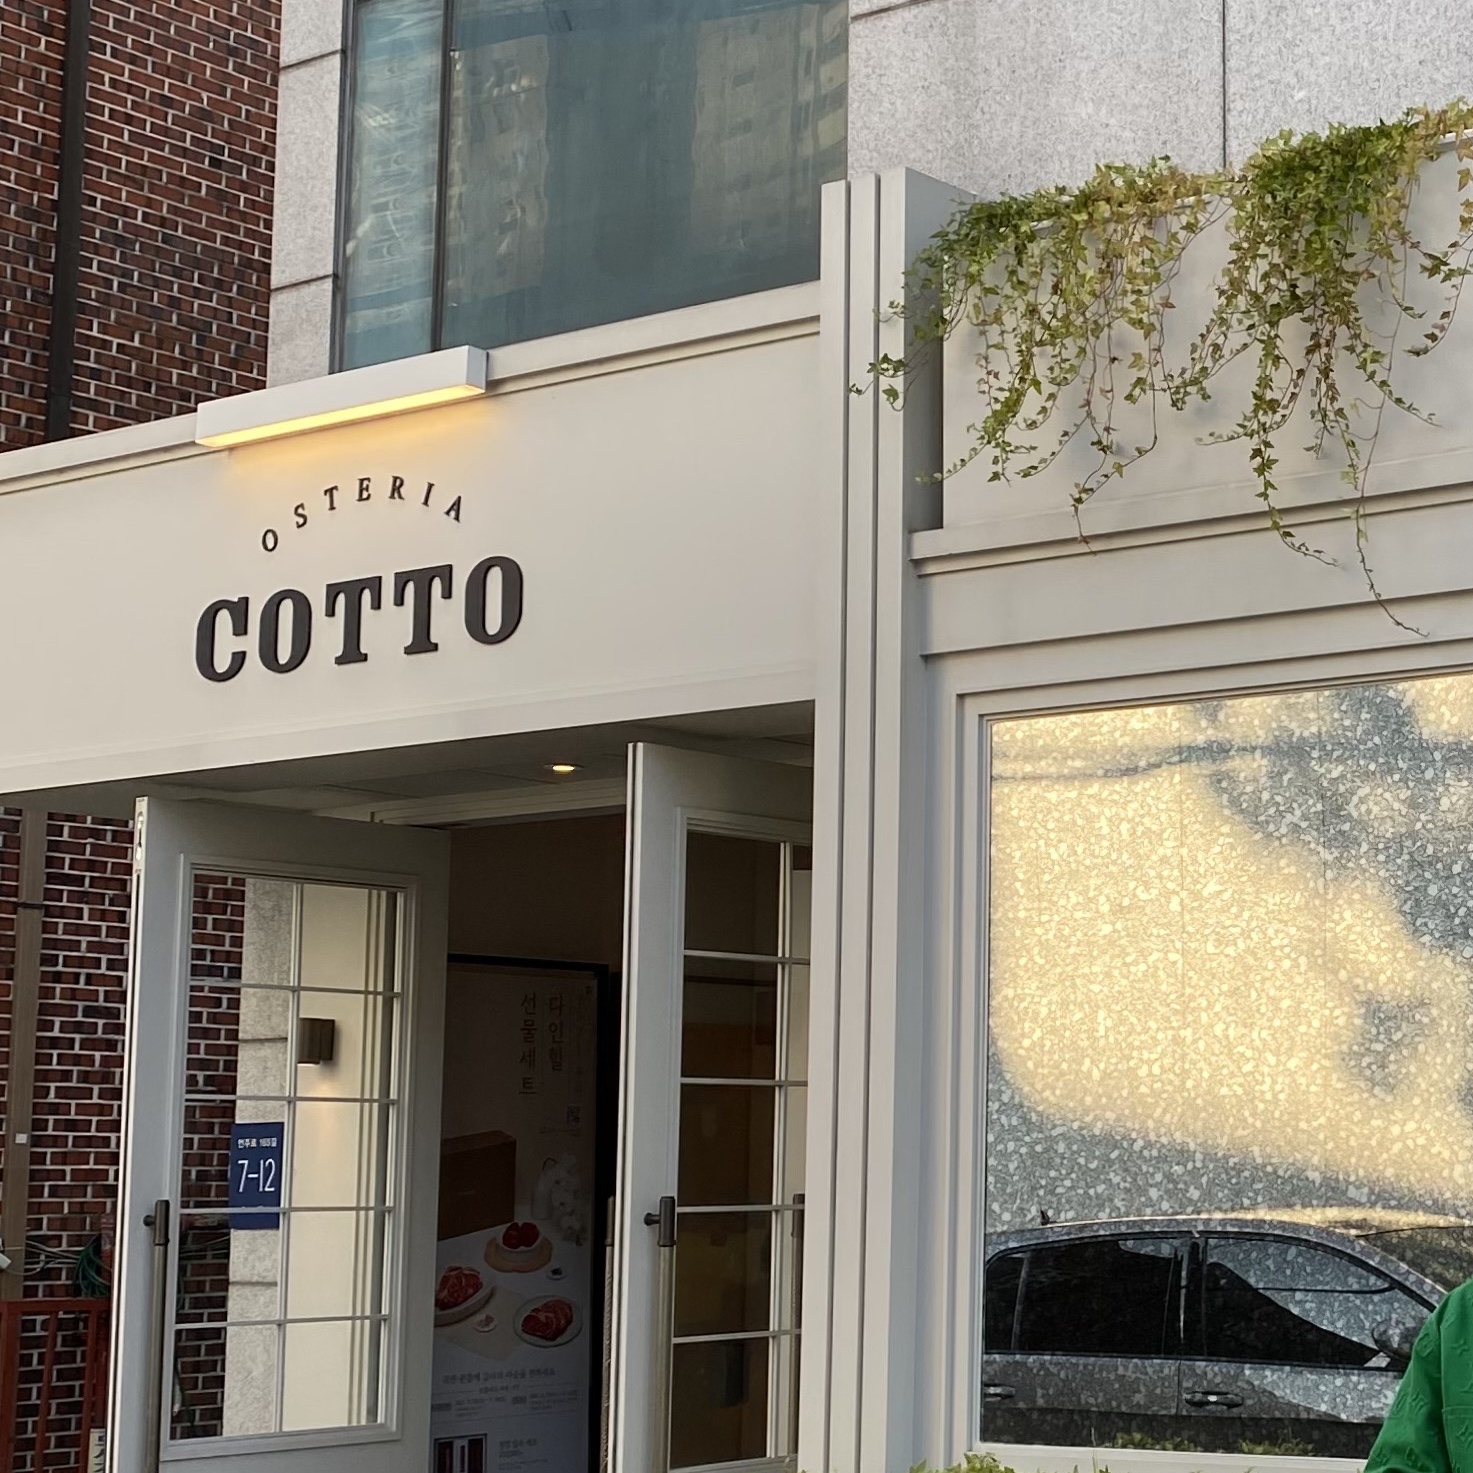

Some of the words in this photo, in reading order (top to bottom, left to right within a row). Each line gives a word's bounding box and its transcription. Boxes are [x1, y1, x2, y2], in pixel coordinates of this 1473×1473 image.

[261, 475, 464, 553] OSTERIA
[195, 555, 525, 683] COTTO
[520, 993, 538, 1095] 선물세트
[238, 1159, 275, 1192] 7-12
